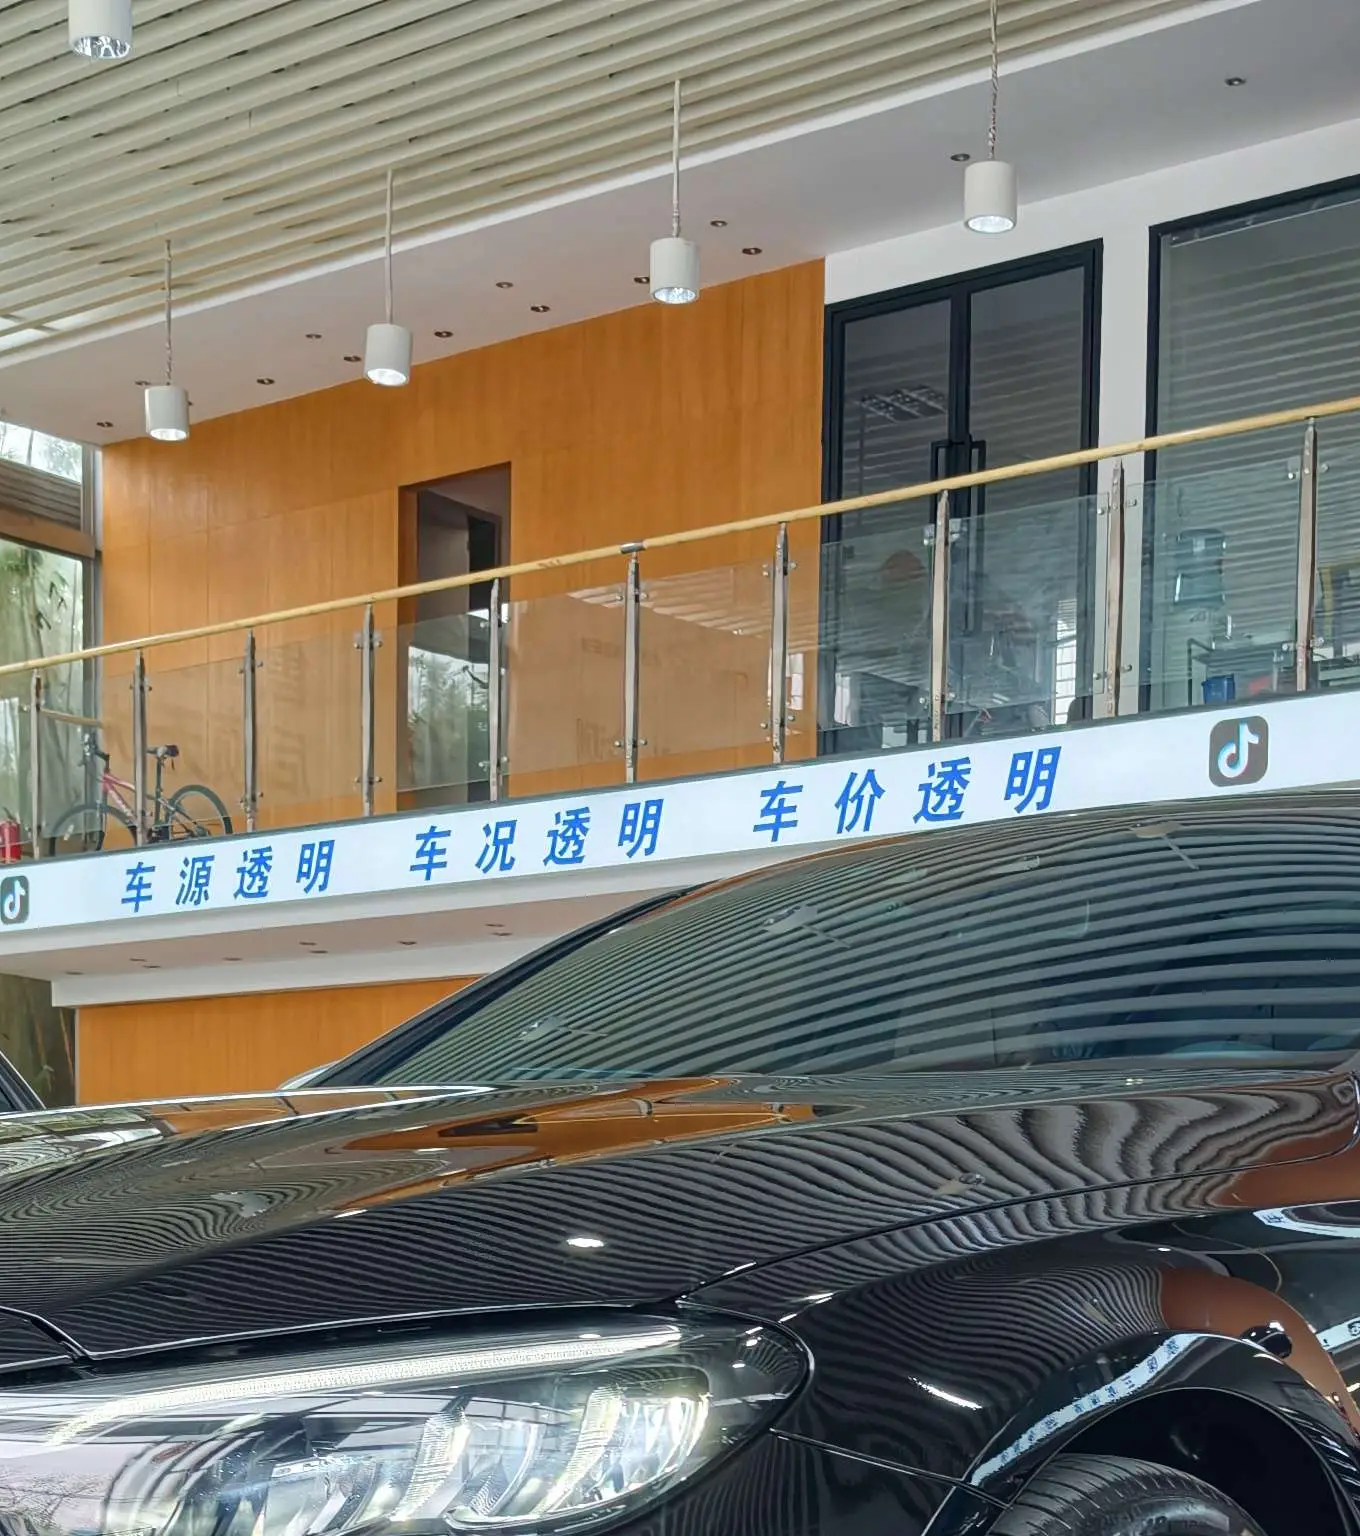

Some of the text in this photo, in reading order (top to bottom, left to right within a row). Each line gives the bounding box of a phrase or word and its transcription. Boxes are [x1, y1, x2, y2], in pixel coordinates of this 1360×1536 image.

[752, 745, 1064, 844] 车价透明
[120, 839, 335, 913] 车源透明
[408, 797, 665, 882] 车况透明
